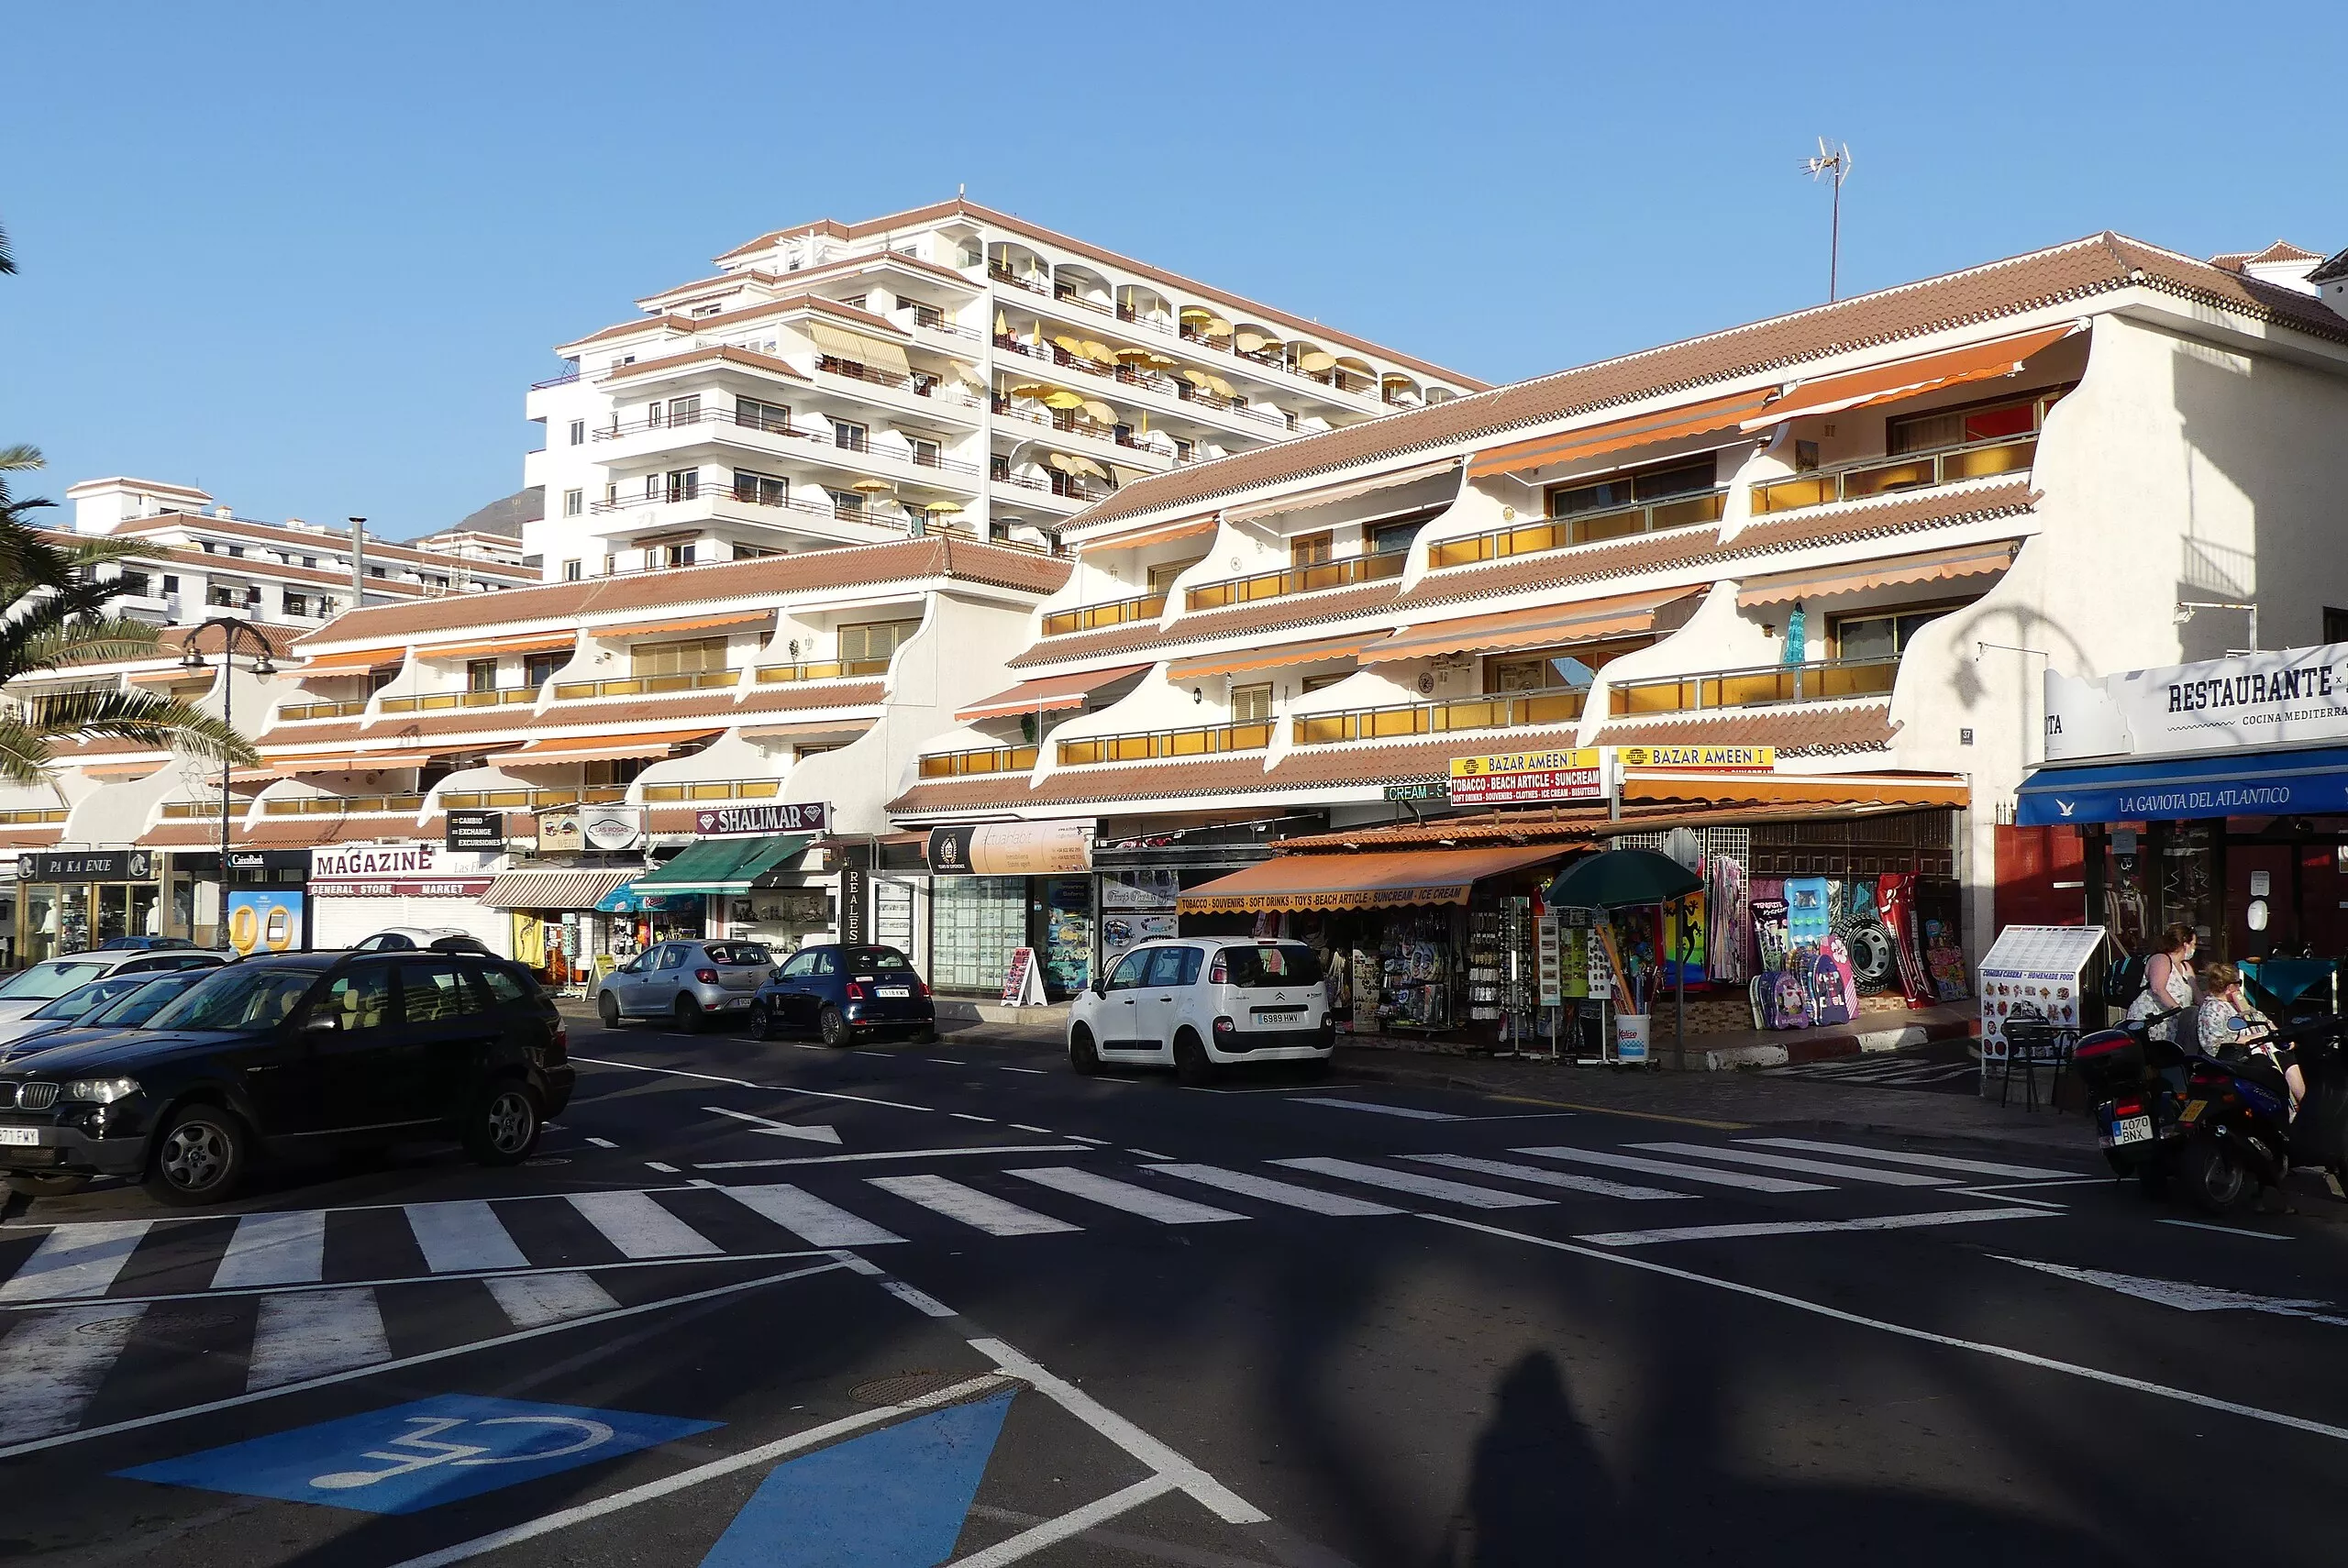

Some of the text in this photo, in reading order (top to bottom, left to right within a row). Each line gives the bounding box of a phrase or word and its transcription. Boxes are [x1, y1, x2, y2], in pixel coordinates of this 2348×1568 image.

[2168, 665, 2332, 712] RESTAURANTE
[2243, 713, 2281, 725] COCINA
[1963, 730, 1971, 738] 37
[1489, 752, 1578, 772] BAZAR AMEEN I
[1654, 749, 1764, 765] BAZAR AMEEN I
[1453, 769, 1600, 792] TOBACCO BEACH ARTICLE SUNCREAM
[1389, 785, 1427, 801] CREAM
[1453, 787, 1600, 803] SOFT DRINKS SOUVENIRS CLOTHES ICE CREAM BISUTERIA
[2120, 787, 2290, 812] LA GAVIOTA DEL ATLANTICO
[718, 806, 802, 833] SHALIMAR
[316, 850, 433, 875] MAGAZINE
[454, 860, 494, 874] Las Flores
[311, 885, 464, 894] GENERAL STORE MARKET
[1181, 899, 1208, 909] TOBACCO
[1212, 898, 1245, 908] SOUVENIRS
[1249, 897, 1266, 907] SOFT
[1266, 896, 1289, 906] DRINKS
[1294, 895, 1312, 905] TOYS
[1338, 892, 1368, 904] ARTICLE
[1373, 890, 1412, 902] SUNCREAM
[1419, 889, 1431, 900] ICE
[1434, 888, 1462, 900] CREAM
[2027, 971, 2057, 980] HOMEMADE
[1263, 1014, 1298, 1023] 6989 HMV
[1618, 1029, 1637, 1040] Kalise
[2121, 1117, 2149, 1131] 4070
[2122, 1129, 2143, 1143] BNX
